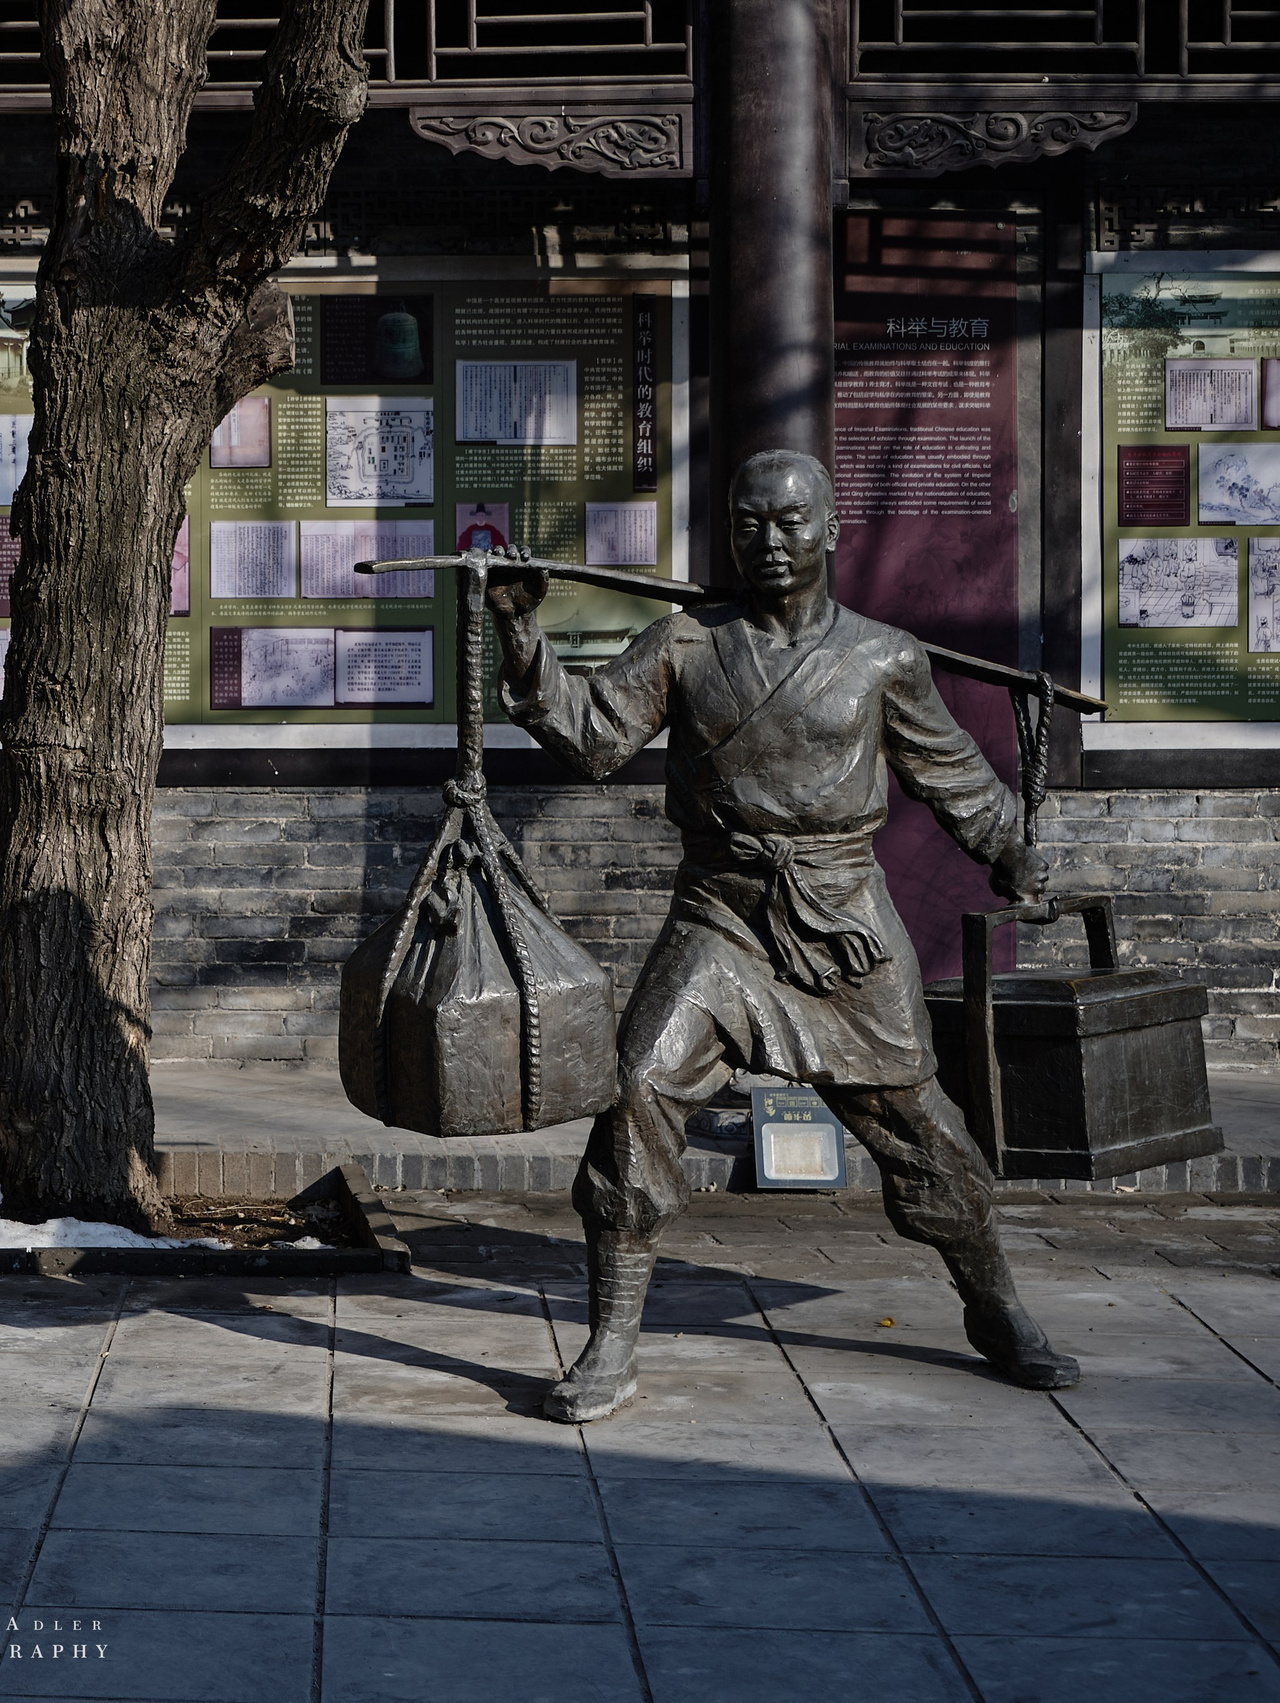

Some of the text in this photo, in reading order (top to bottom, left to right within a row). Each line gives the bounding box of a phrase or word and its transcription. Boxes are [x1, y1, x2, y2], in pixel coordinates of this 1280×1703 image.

[886, 317, 990, 339] 科举与教育
[852, 342, 917, 351] EXAMINATIONS
[919, 342, 938, 351] AND
[940, 342, 990, 351] EDUCATION
[636, 312, 653, 472] 科举时代的教育组织
